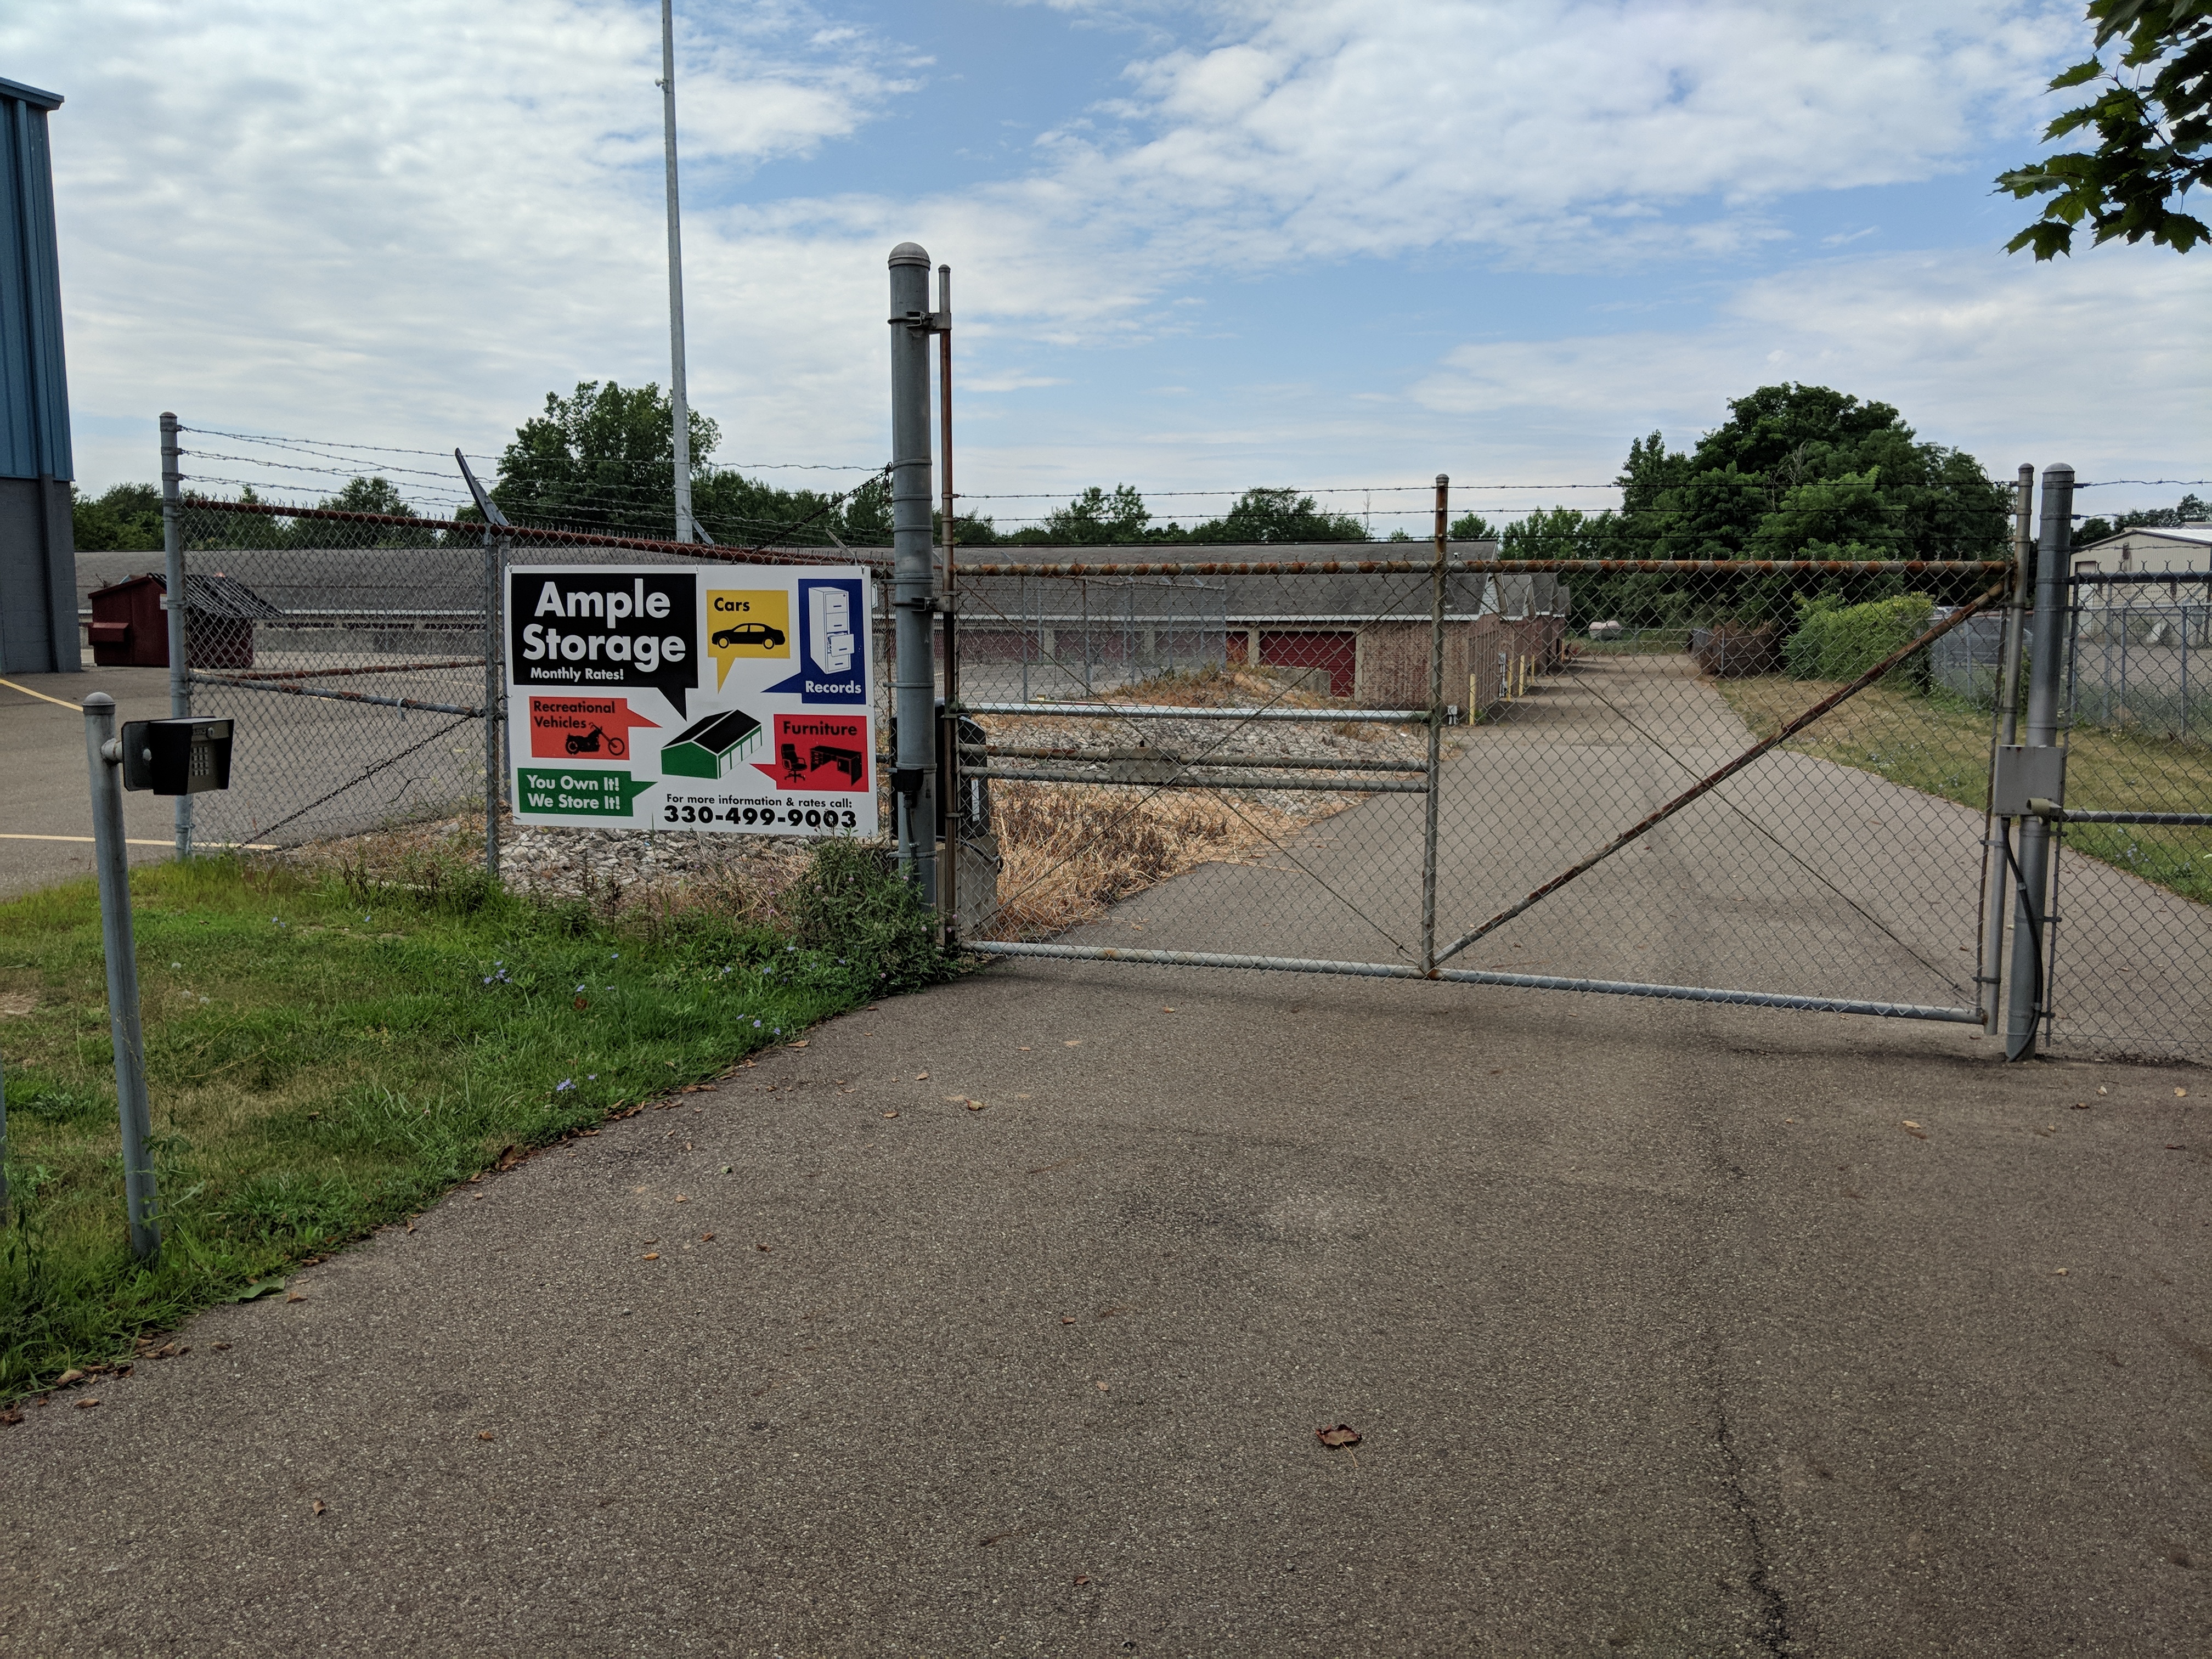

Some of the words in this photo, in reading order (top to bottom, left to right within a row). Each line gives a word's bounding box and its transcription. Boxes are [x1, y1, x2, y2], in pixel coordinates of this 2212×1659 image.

[534, 578, 670, 629] Ample
[714, 597, 750, 612] Cars
[523, 623, 686, 672] Storage
[531, 667, 581, 682] Monthly
[585, 668, 624, 680] Rates!
[805, 680, 862, 693] Records
[534, 701, 615, 713] Recreational
[534, 716, 586, 729] Vehicles
[783, 721, 857, 735] Furniture
[527, 775, 555, 789] You
[561, 775, 599, 791] Own
[603, 777, 619, 791] It!
[527, 793, 554, 807] We
[558, 794, 599, 809] Store
[604, 796, 620, 810] It!
[667, 794, 684, 803] For
[719, 795, 782, 806] information
[786, 798, 794, 806] &
[799, 798, 826, 807] rates
[830, 798, 852, 808] call:
[664, 805, 856, 827] 330-499-9003
